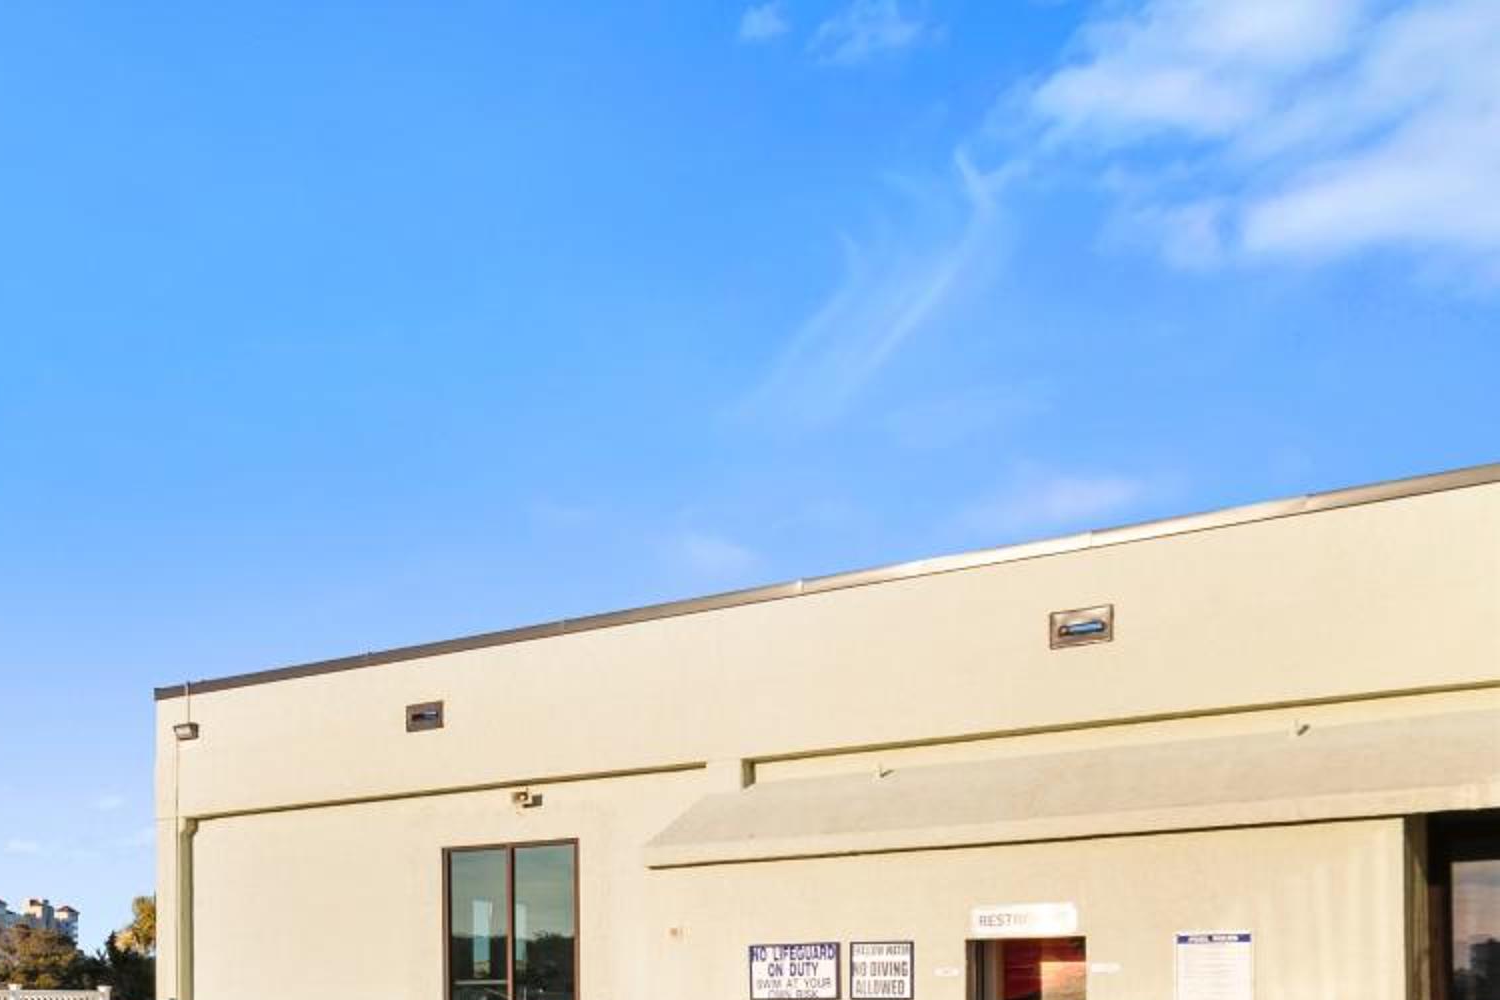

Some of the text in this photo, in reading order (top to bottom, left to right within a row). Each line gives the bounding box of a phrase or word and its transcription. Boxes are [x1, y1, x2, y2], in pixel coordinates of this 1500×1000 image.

[751, 943, 835, 962] NO LIFEGUARD
[767, 961, 819, 977] ON DUTY
[852, 961, 908, 977] NO DIVING
[786, 977, 799, 989] AT
[803, 976, 831, 989] YOUR
[855, 979, 905, 995] ALLOWED
